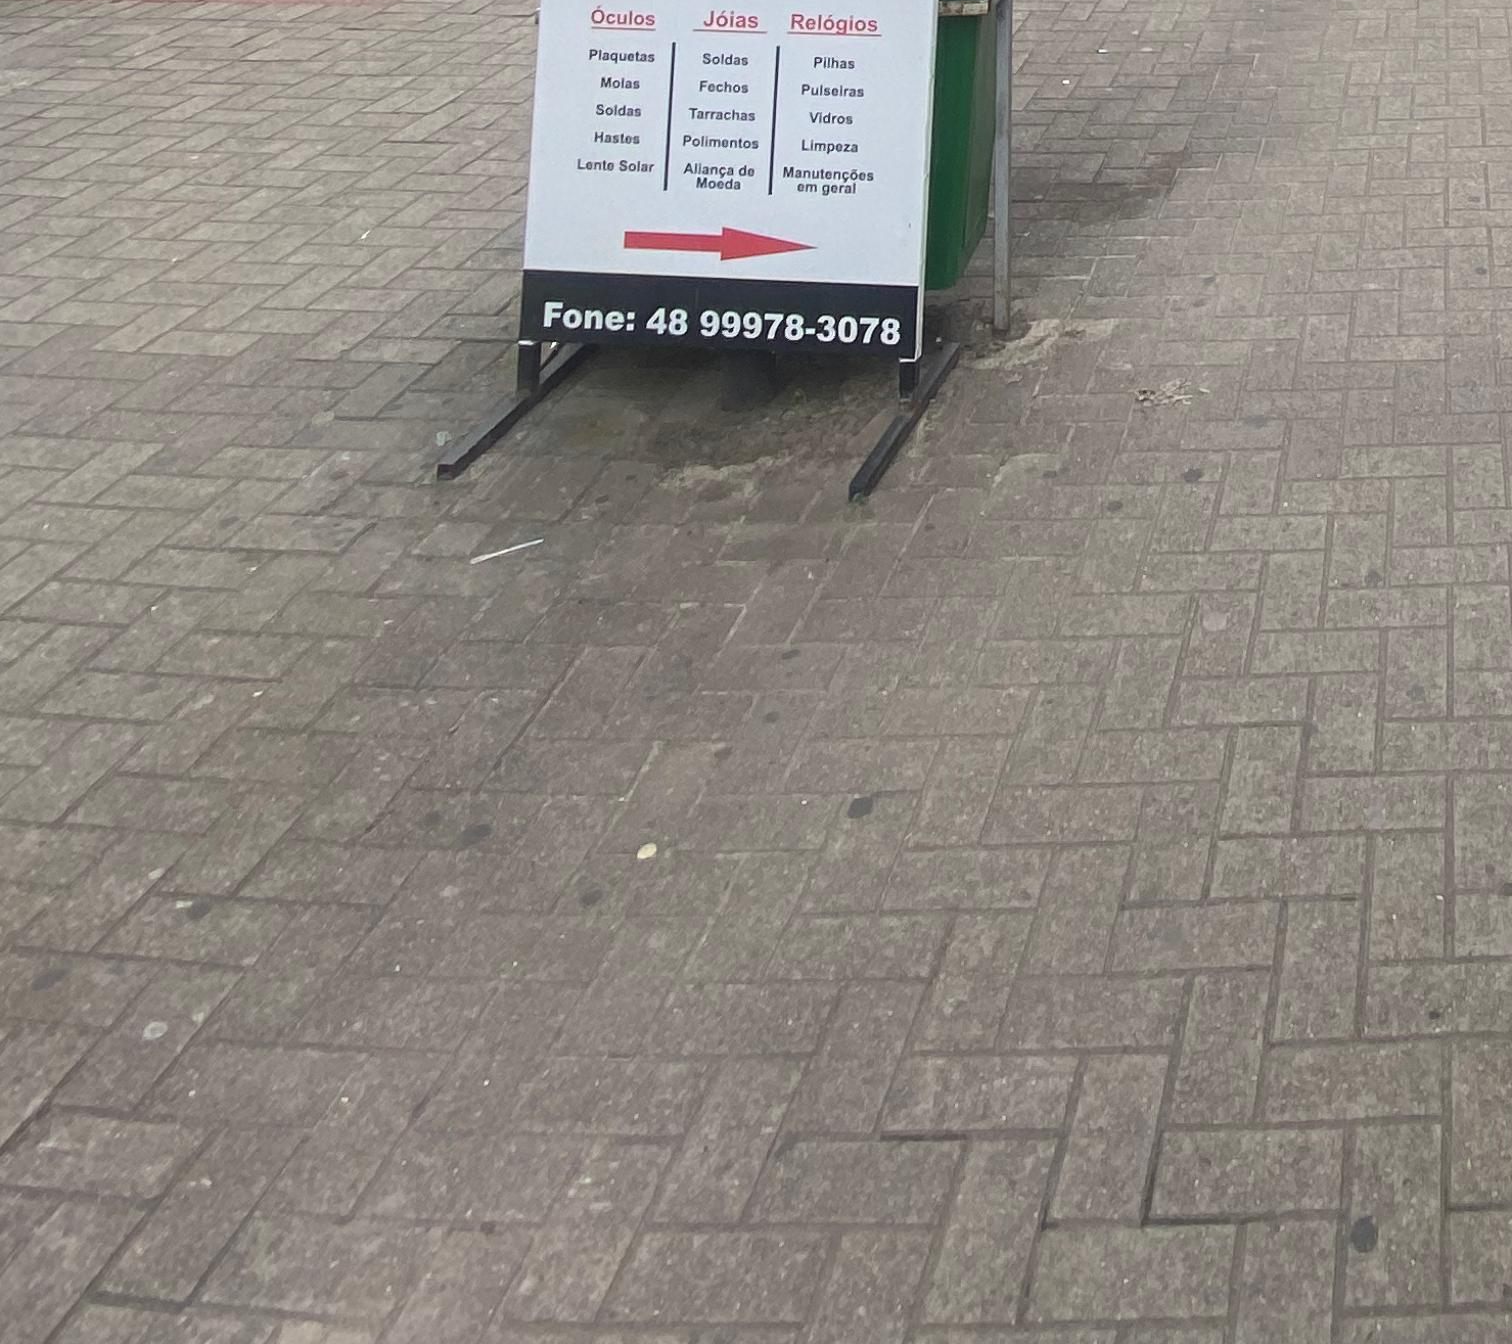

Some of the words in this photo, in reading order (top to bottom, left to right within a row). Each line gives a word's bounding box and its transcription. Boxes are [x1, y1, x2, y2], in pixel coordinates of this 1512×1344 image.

[590, 6, 656, 28] Óculos
[703, 9, 759, 29] Jóias
[790, 13, 879, 35] Relógios
[588, 48, 655, 66] Plaquetas
[702, 52, 749, 67] Soldas
[813, 56, 855, 70] Pilhas
[600, 76, 641, 90] Molas
[699, 79, 749, 94] Fechos
[801, 83, 865, 98] Pulseiras
[595, 103, 642, 118] Soldas
[688, 107, 756, 122] Tarrachas
[809, 111, 854, 125] Vidros
[594, 131, 641, 145] Hastes
[682, 134, 759, 150] Polimentos
[801, 139, 859, 155] Limpeza
[577, 158, 611, 172] Lente
[614, 159, 655, 173] Solar
[683, 162, 735, 180] Aliança
[738, 164, 756, 177] de
[782, 165, 875, 185] Manutenções
[696, 176, 742, 191] Moeda
[797, 183, 818, 194] em
[822, 180, 857, 197] geral
[542, 301, 636, 332] Fone:
[645, 307, 688, 336] 48
[700, 310, 901, 345] 99978-3078
